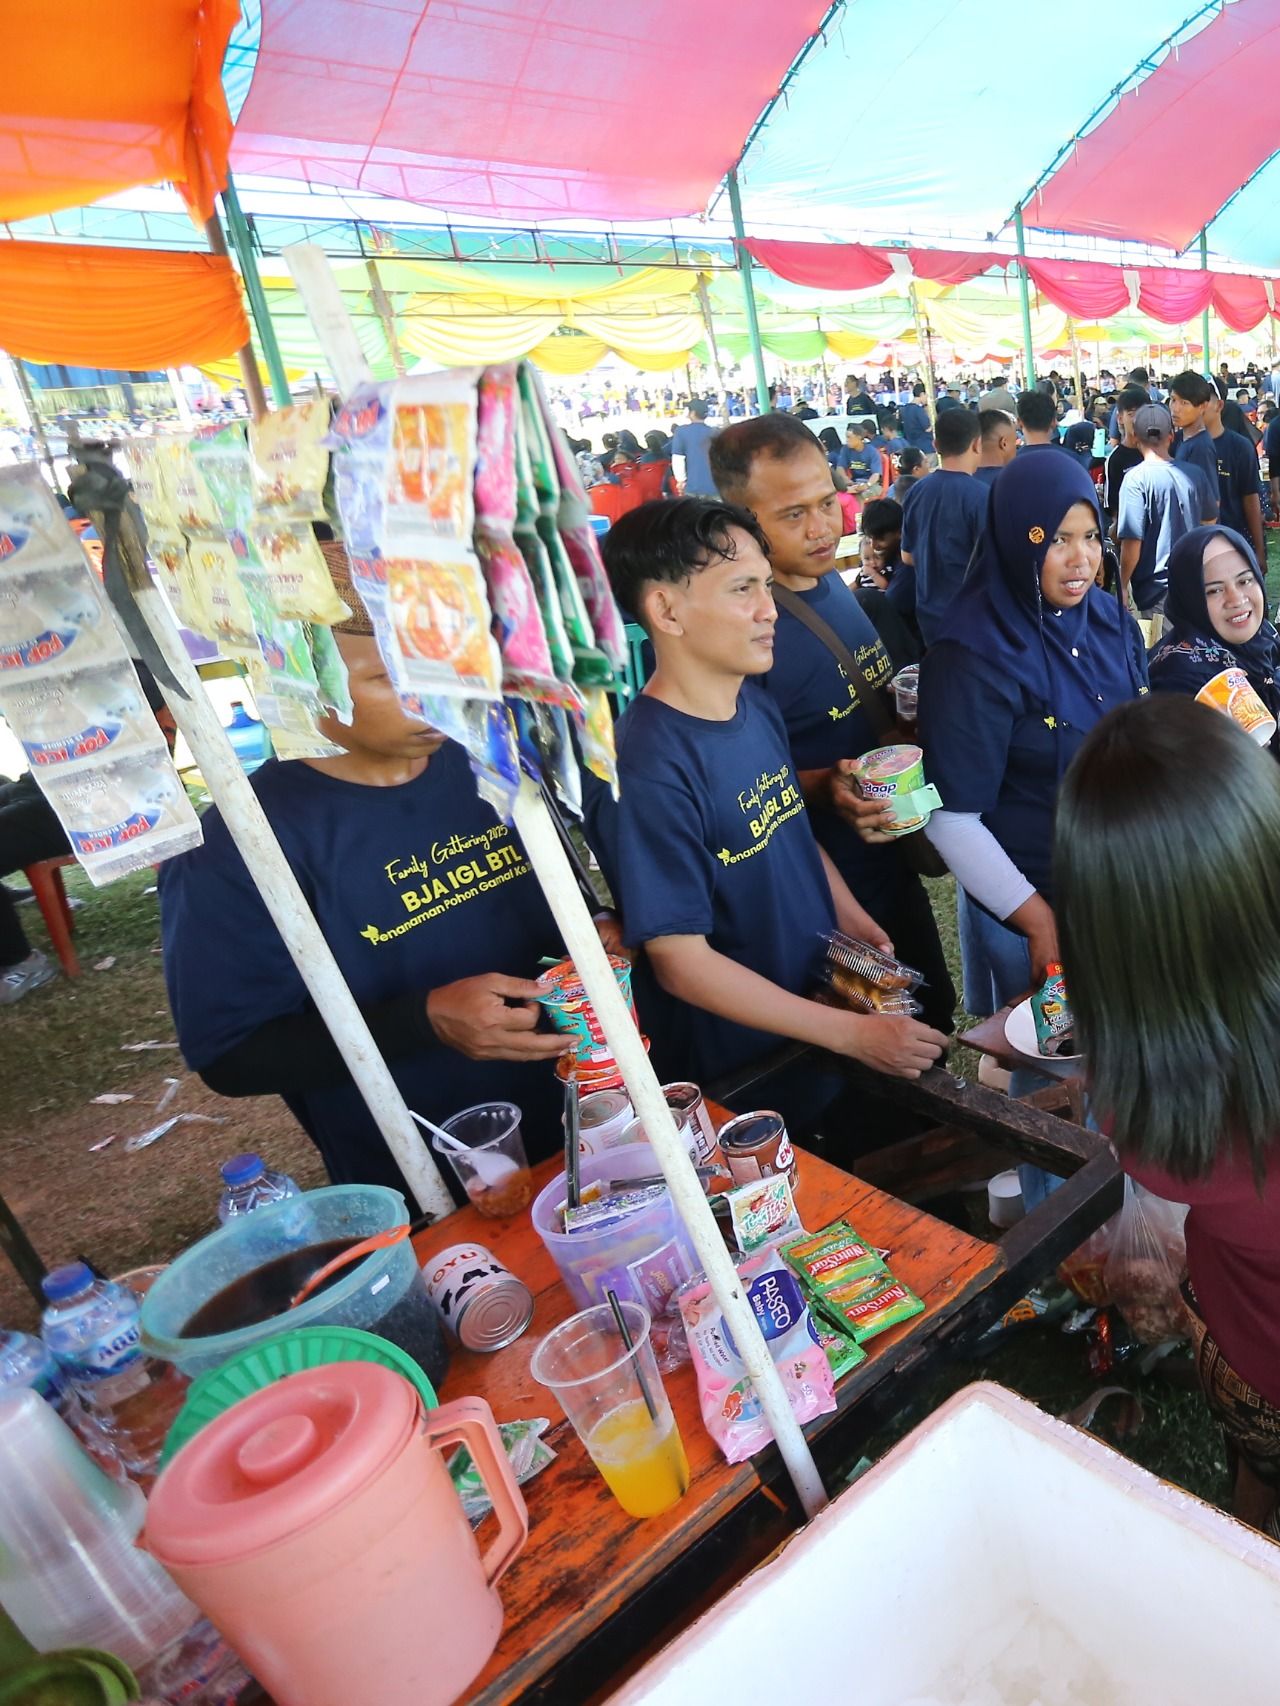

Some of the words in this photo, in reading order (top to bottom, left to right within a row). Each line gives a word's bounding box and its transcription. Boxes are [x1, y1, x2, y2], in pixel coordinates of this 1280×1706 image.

[73, 728, 110, 756] POP
[33, 749, 71, 765] ICE
[864, 782, 898, 794] daap
[118, 815, 151, 840] POP
[79, 838, 113, 853] ICE
[384, 854, 428, 885] Family
[431, 834, 490, 865] Gathering
[401, 877, 450, 912] BJA
[447, 860, 488, 889] IGL
[485, 844, 522, 872] BTL
[369, 903, 446, 946] Penanaman
[443, 887, 479, 911] Pohon
[479, 869, 513, 892] Gamal
[1048, 985, 1066, 996] Se
[752, 1293, 766, 1317] Baby
[758, 1276, 793, 1330] PASEO
[98, 1324, 140, 1361] AQU
